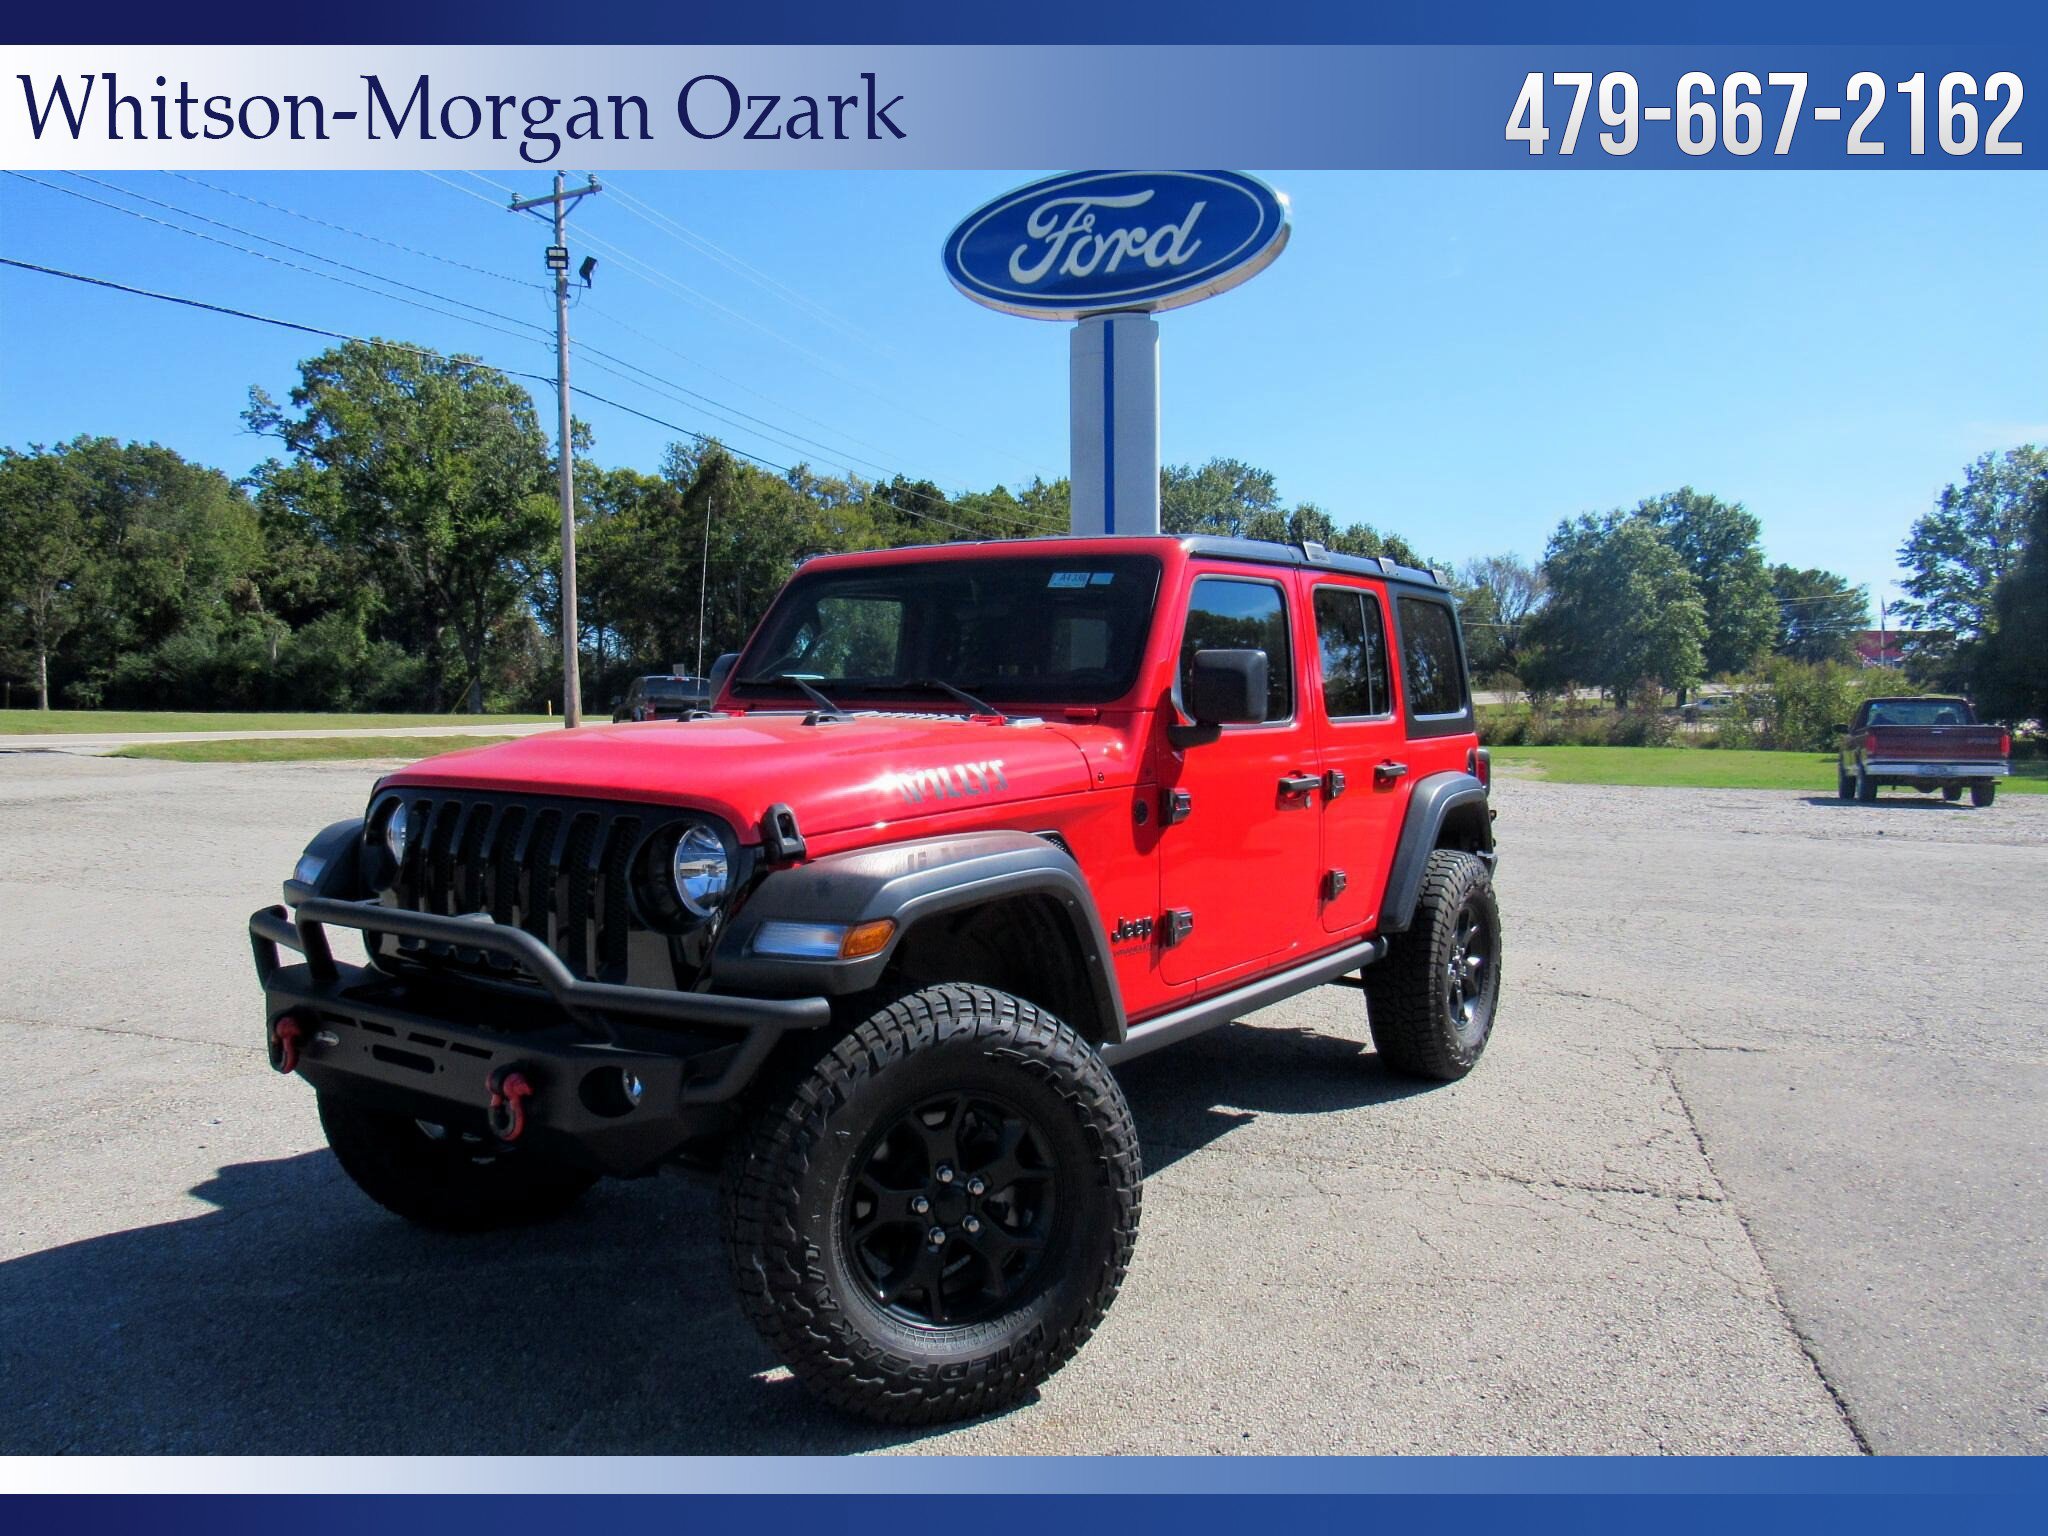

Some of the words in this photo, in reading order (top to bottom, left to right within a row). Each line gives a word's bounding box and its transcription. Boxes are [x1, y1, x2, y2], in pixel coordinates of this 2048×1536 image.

[1009, 189, 1207, 284] Ford
[1111, 916, 1152, 942] Jeep
[831, 1315, 1047, 1383] WILDPEAK
